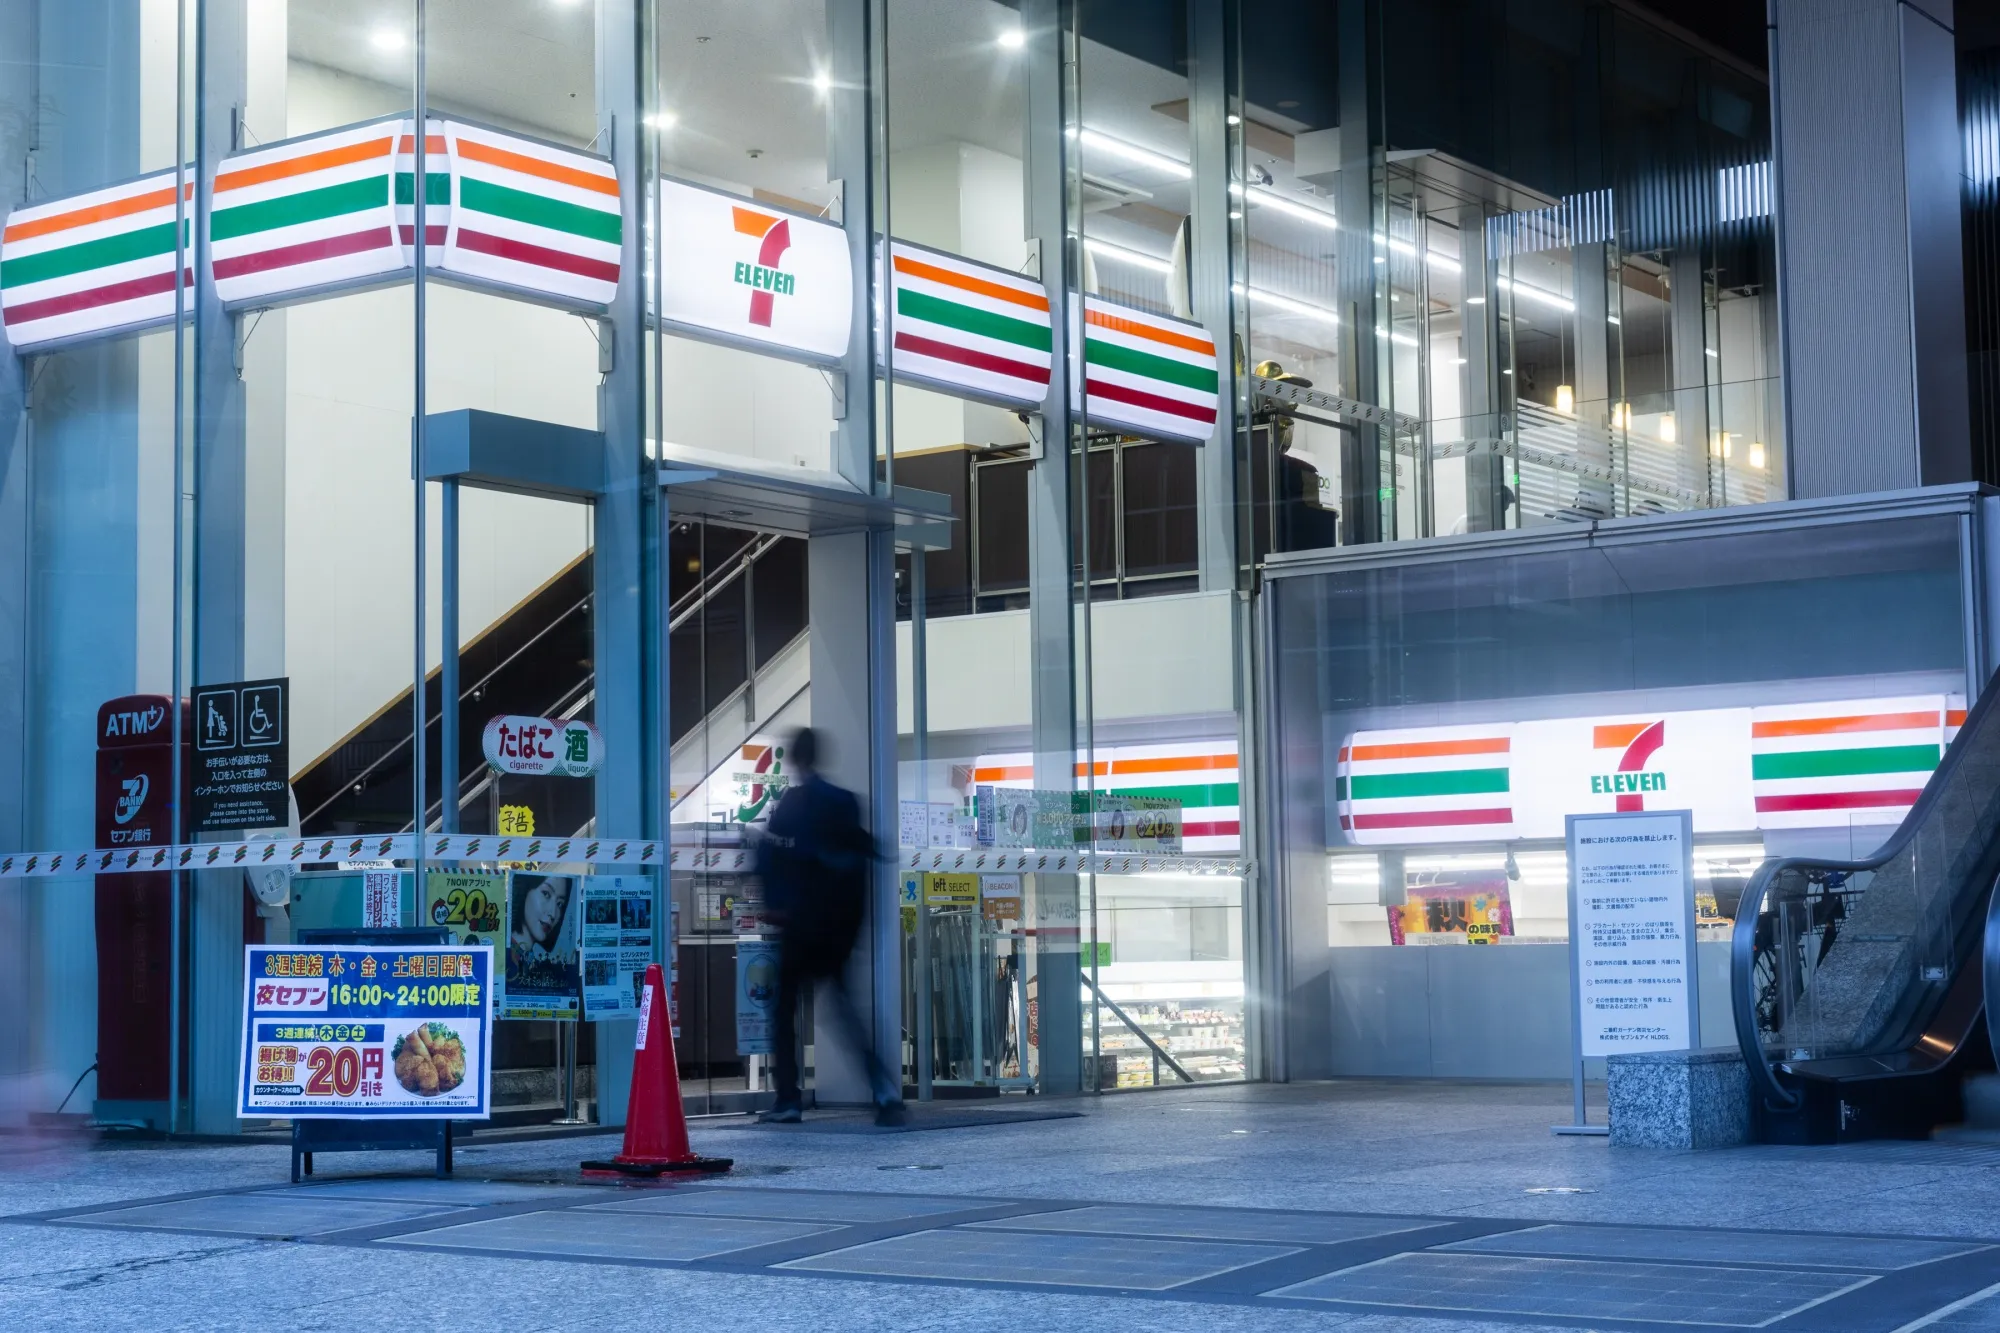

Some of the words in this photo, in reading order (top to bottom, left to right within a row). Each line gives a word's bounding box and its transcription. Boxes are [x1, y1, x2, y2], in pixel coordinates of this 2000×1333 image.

[498, 723, 554, 760] たばこ
[564, 728, 589, 763] 酒
[206, 754, 272, 768] お手伝いが必要な方は、
[509, 760, 544, 772] cigarette
[566, 764, 590, 775] liquor
[211, 769, 267, 782] 入口を入って左側の
[194, 781, 285, 797] インターホンでお知らせください
[218, 802, 227, 810] you
[209, 810, 225, 818] please
[220, 817, 240, 825] intercom
[501, 809, 530, 833] 予告
[1580, 834, 1677, 844] 施設における次の行為を禁止します。
[619, 889, 639, 897] Creepy
[948, 882, 970, 892] SELECT
[265, 954, 323, 977] 3週連続
[328, 954, 473, 978] 木・金・土曜日開催
[256, 984, 327, 1006] 夜セブン
